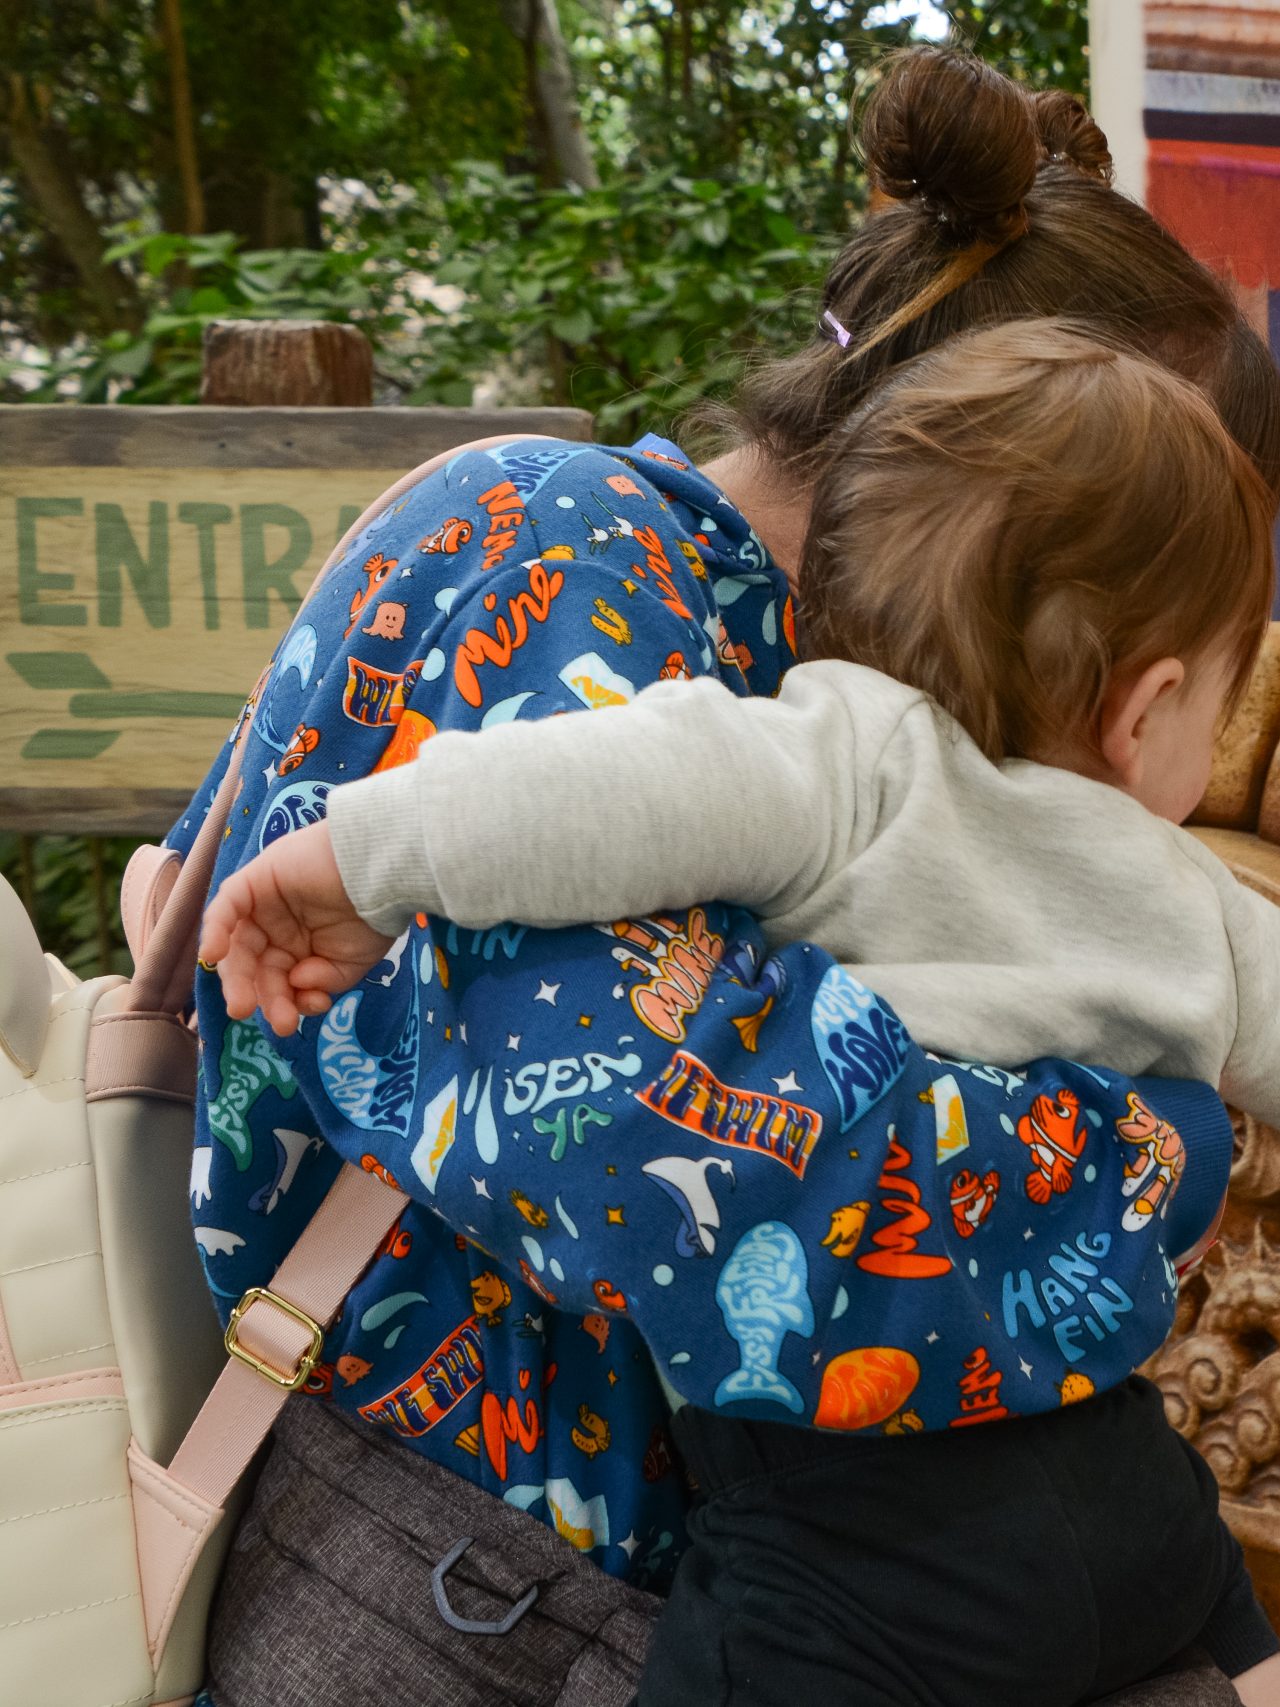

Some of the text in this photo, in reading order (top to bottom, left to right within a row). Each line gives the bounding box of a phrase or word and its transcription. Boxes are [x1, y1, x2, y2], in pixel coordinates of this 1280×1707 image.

[16, 497, 362, 631] ENTR
[454, 563, 565, 708] Mine
[320, 996, 377, 1118] MAKING
[368, 1014, 419, 1131] WAVES
[533, 1104, 613, 1161] YA
[1002, 1232, 1112, 1338] HANG
[1053, 1277, 1134, 1362] FIN
